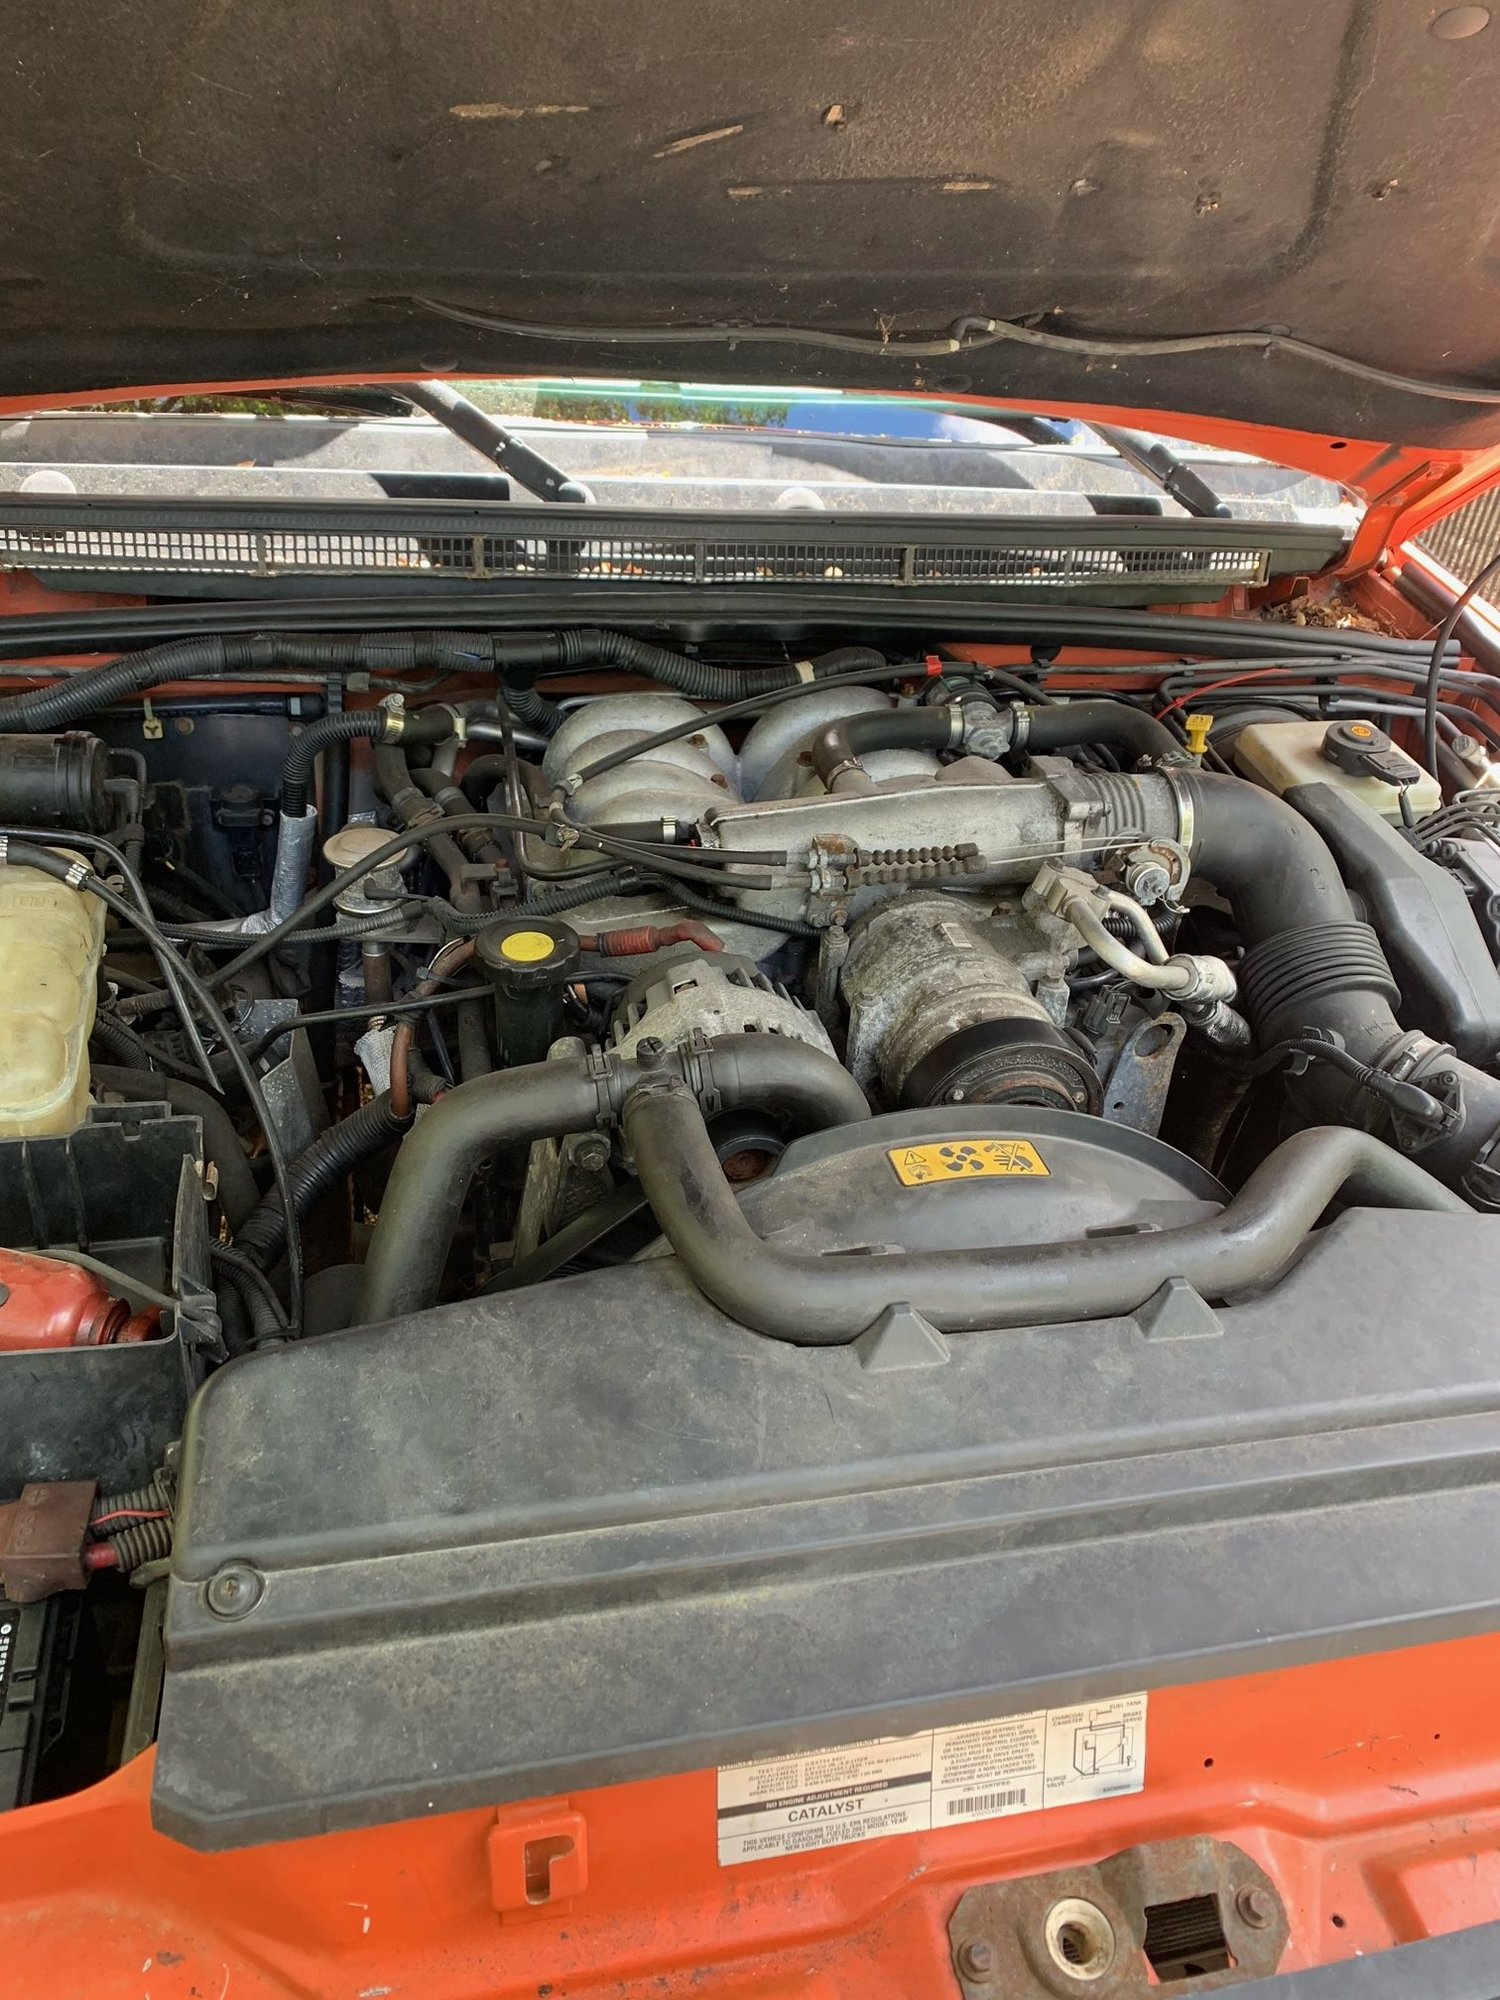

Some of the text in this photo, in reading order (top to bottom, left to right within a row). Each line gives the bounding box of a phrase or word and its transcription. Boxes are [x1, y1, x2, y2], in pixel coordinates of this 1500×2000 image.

[779, 1797, 805, 1807] ENGINE
[806, 1788, 853, 1802] ADJUSTMENT
[854, 1781, 888, 1793] REQUIRED
[788, 1797, 864, 1823] CATALYST
[742, 1841, 778, 1853] APPLICABLE
[792, 1833, 823, 1844] GASOLINE
[826, 1828, 850, 1837] FUELED
[867, 1821, 888, 1830] MODEL
[891, 1818, 907, 1826] YEAR
[759, 1834, 784, 1844] VEHICLE
[786, 1827, 823, 1839] CONFORMS
[862, 1812, 906, 1825] REGULATIONS
[801, 1840, 820, 1848] LIGHT
[821, 1837, 838, 1845] DUTY
[841, 1832, 865, 1841] TRUCKS
